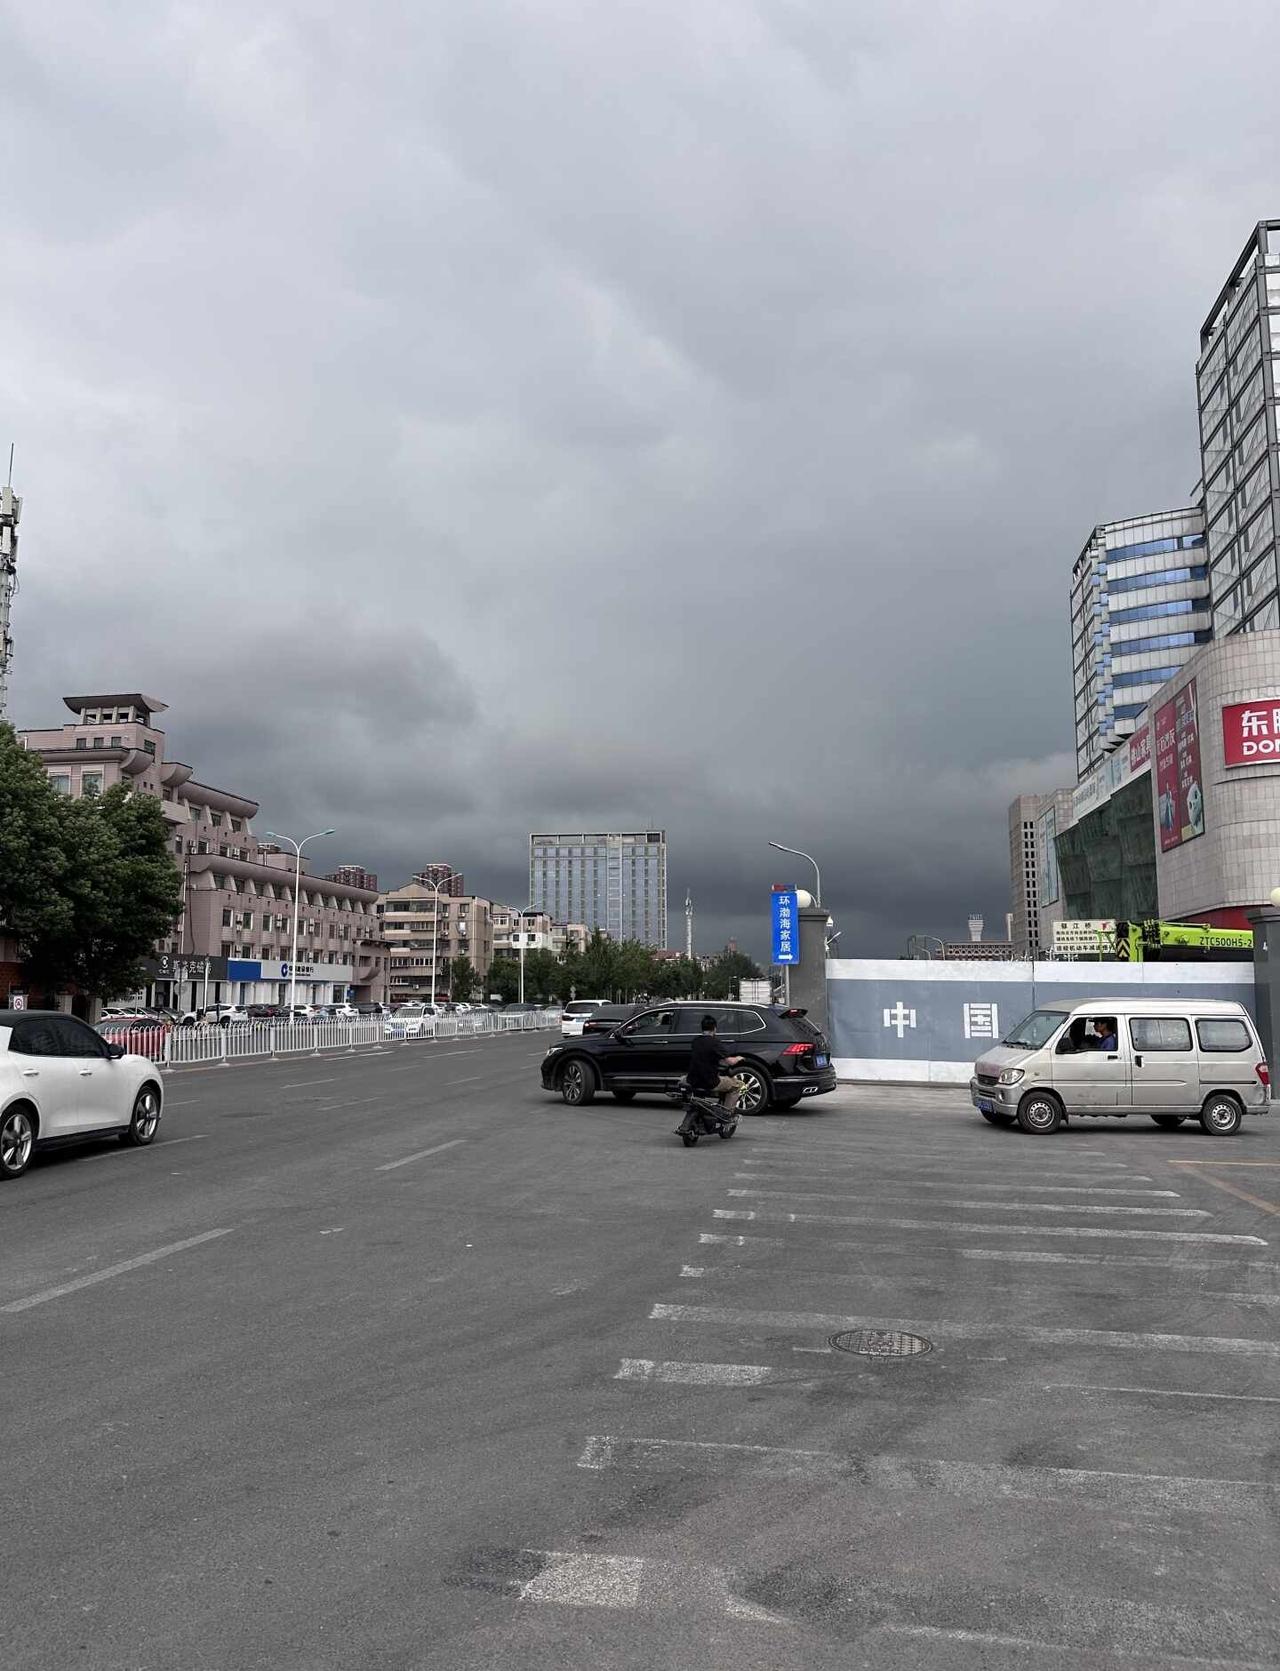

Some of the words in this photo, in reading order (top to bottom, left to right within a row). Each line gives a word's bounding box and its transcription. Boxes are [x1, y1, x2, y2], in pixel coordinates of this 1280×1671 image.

[1240, 709, 1280, 738] 东
[778, 895, 792, 952] 环渤海家居
[882, 1000, 999, 1039] 中国
